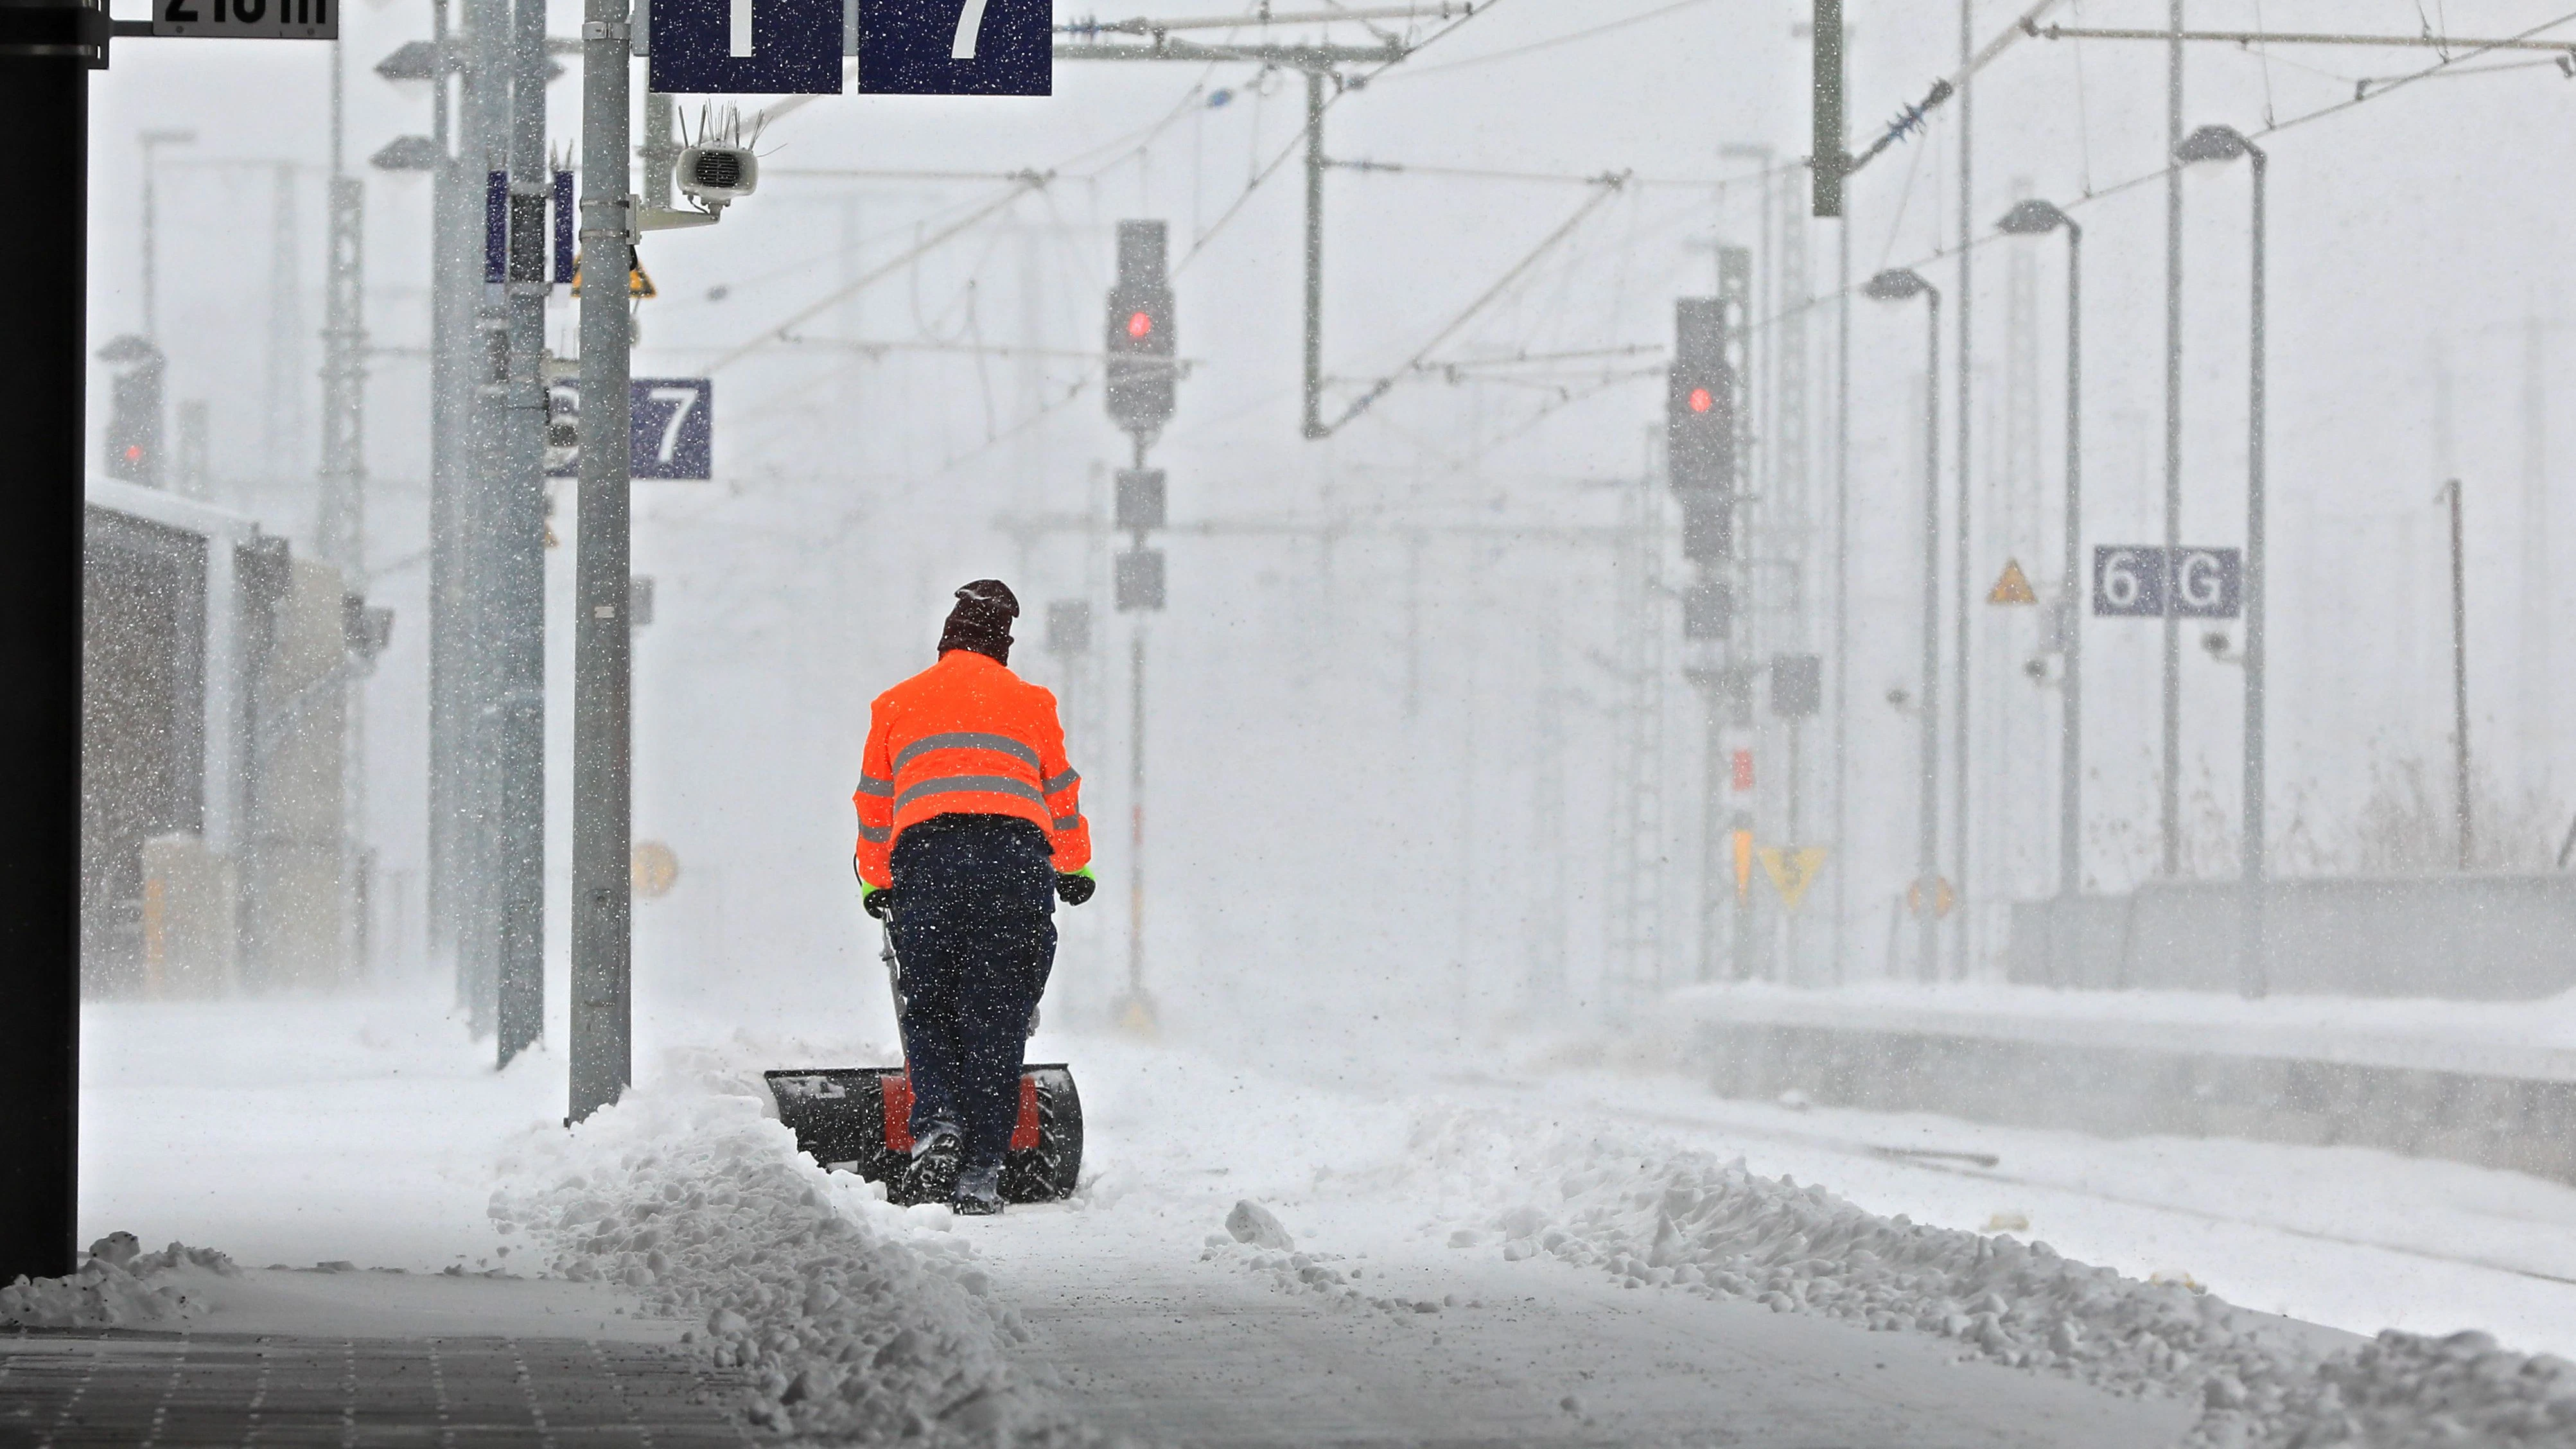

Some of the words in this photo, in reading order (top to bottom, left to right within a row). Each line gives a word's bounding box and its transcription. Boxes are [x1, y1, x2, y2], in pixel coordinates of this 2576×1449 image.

[648, 387, 698, 463] 7
[2104, 551, 2139, 607] 6
[2181, 552, 2221, 606] G
